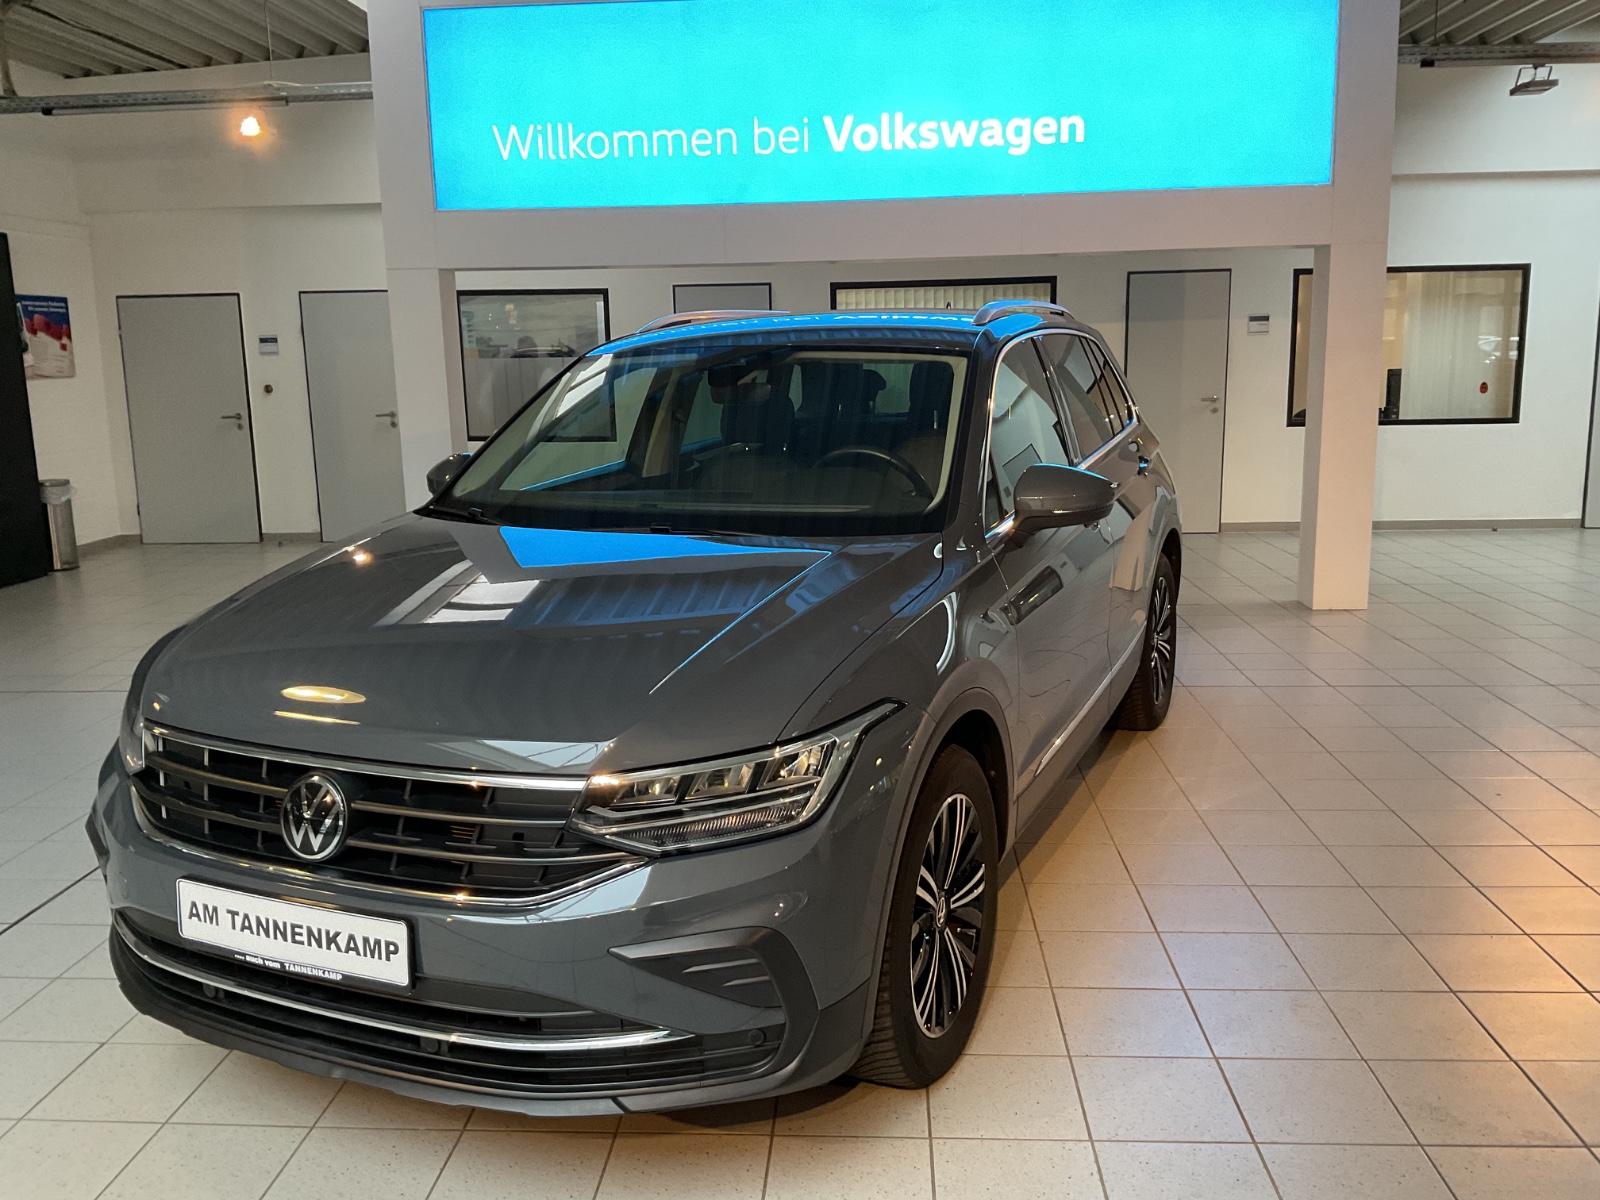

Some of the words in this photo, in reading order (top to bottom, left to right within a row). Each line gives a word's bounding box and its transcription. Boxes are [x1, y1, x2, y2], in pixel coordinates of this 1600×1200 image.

[492, 122, 738, 161] Willkommen
[753, 117, 810, 156] bei
[823, 112, 1085, 156] Volkswagen
[283, 774, 345, 860] VW
[188, 901, 219, 927] AM
[226, 908, 400, 963] TANNENKAMP
[284, 963, 343, 981] TANNENKAMP
